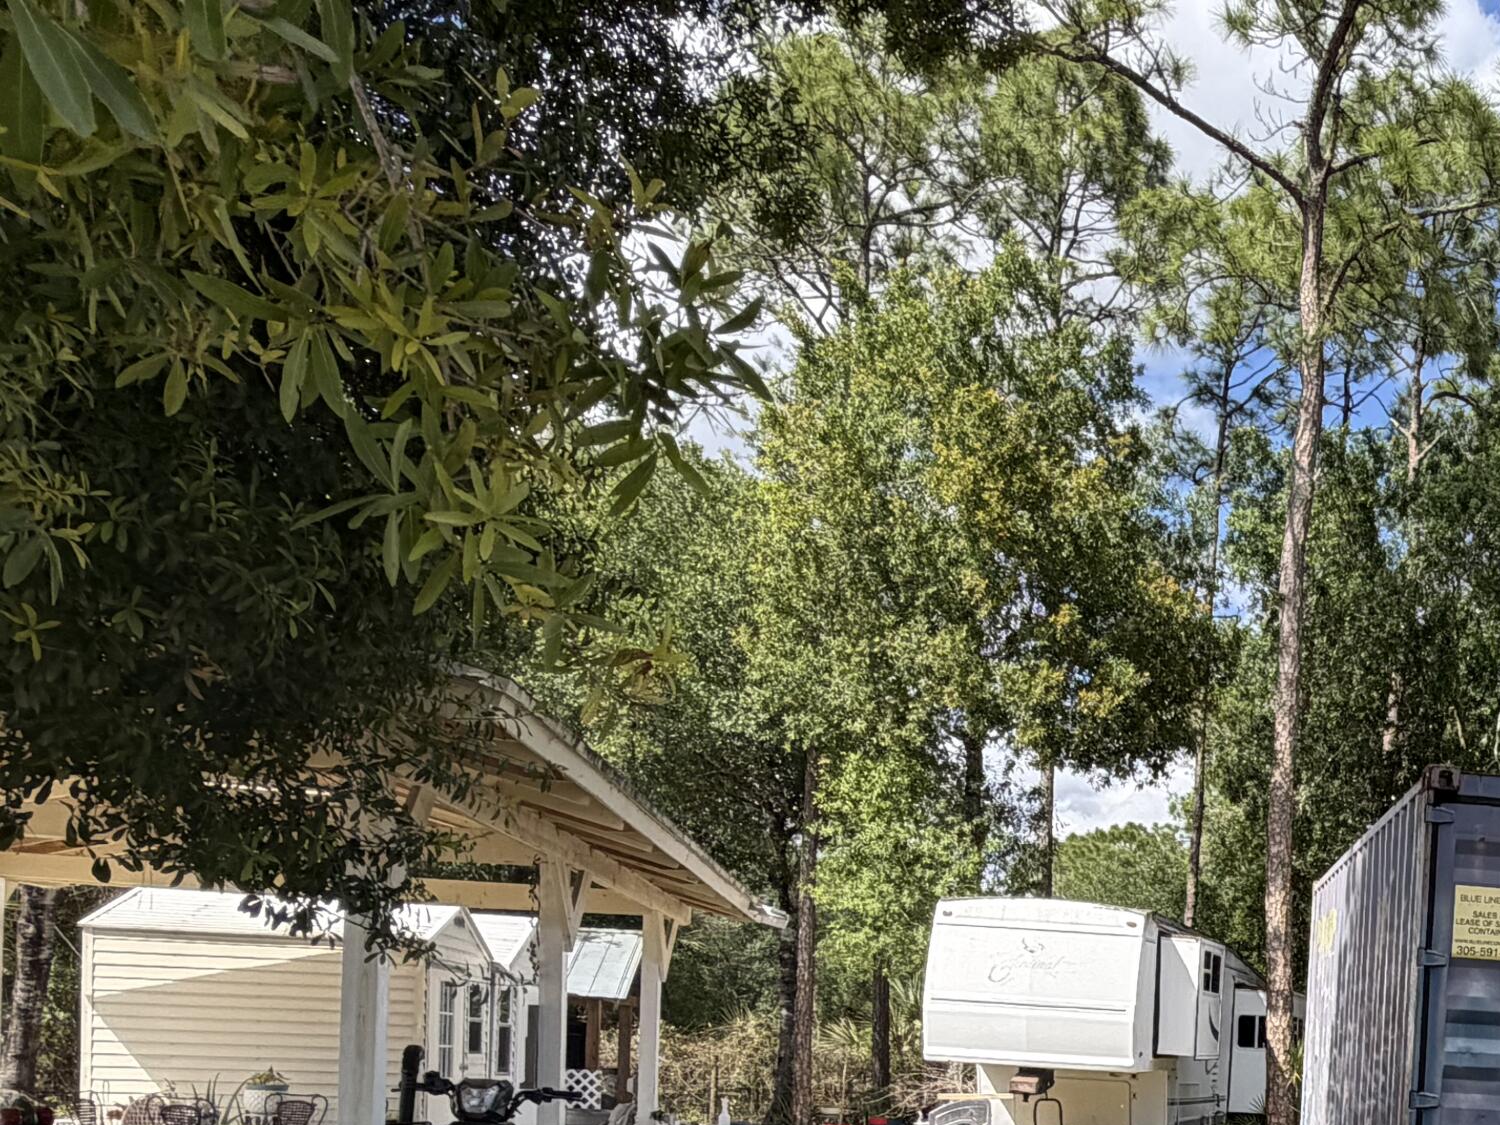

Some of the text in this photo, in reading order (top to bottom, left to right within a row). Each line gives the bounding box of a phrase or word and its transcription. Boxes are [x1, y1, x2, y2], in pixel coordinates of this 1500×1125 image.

[1460, 894, 1500, 904] BLUE LINE
[1472, 911, 1497, 919] SALES
[1456, 918, 1480, 926] LEASE
